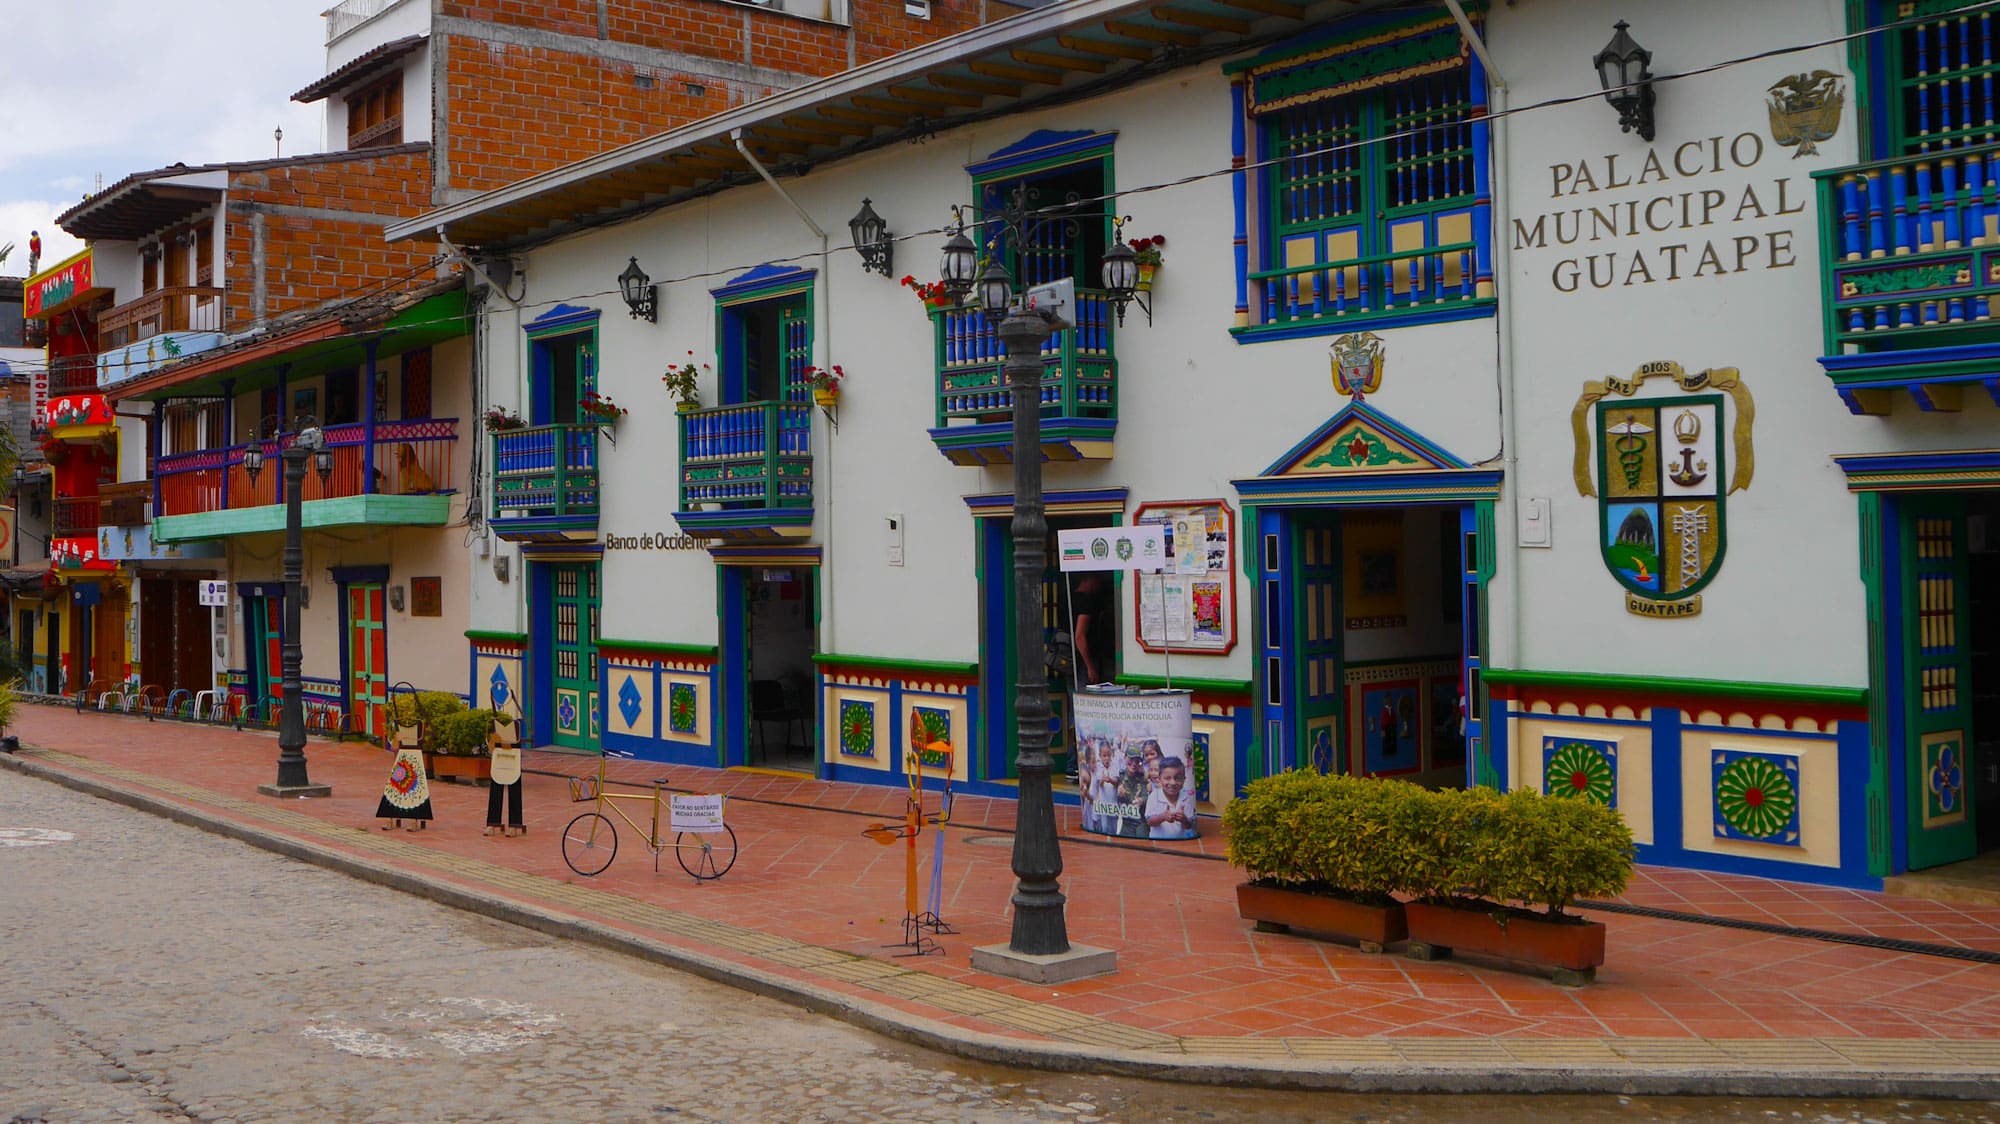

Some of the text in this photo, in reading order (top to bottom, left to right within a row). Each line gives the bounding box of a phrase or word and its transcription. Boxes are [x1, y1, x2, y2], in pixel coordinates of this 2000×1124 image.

[1550, 132, 1765, 198] PALACIO
[1512, 178, 1806, 250] MUNICIPAL
[1551, 229, 1797, 293] GUATAPE
[1608, 362, 1671, 393] PAZ DIOS
[606, 531, 711, 550] Banco de Occidente
[1087, 699, 1114, 709] INFANCIA
[1120, 700, 1183, 710] ADOLESCENCIA
[1132, 712, 1172, 721] ANTIOQUIA
[1122, 806, 1139, 817] 141
